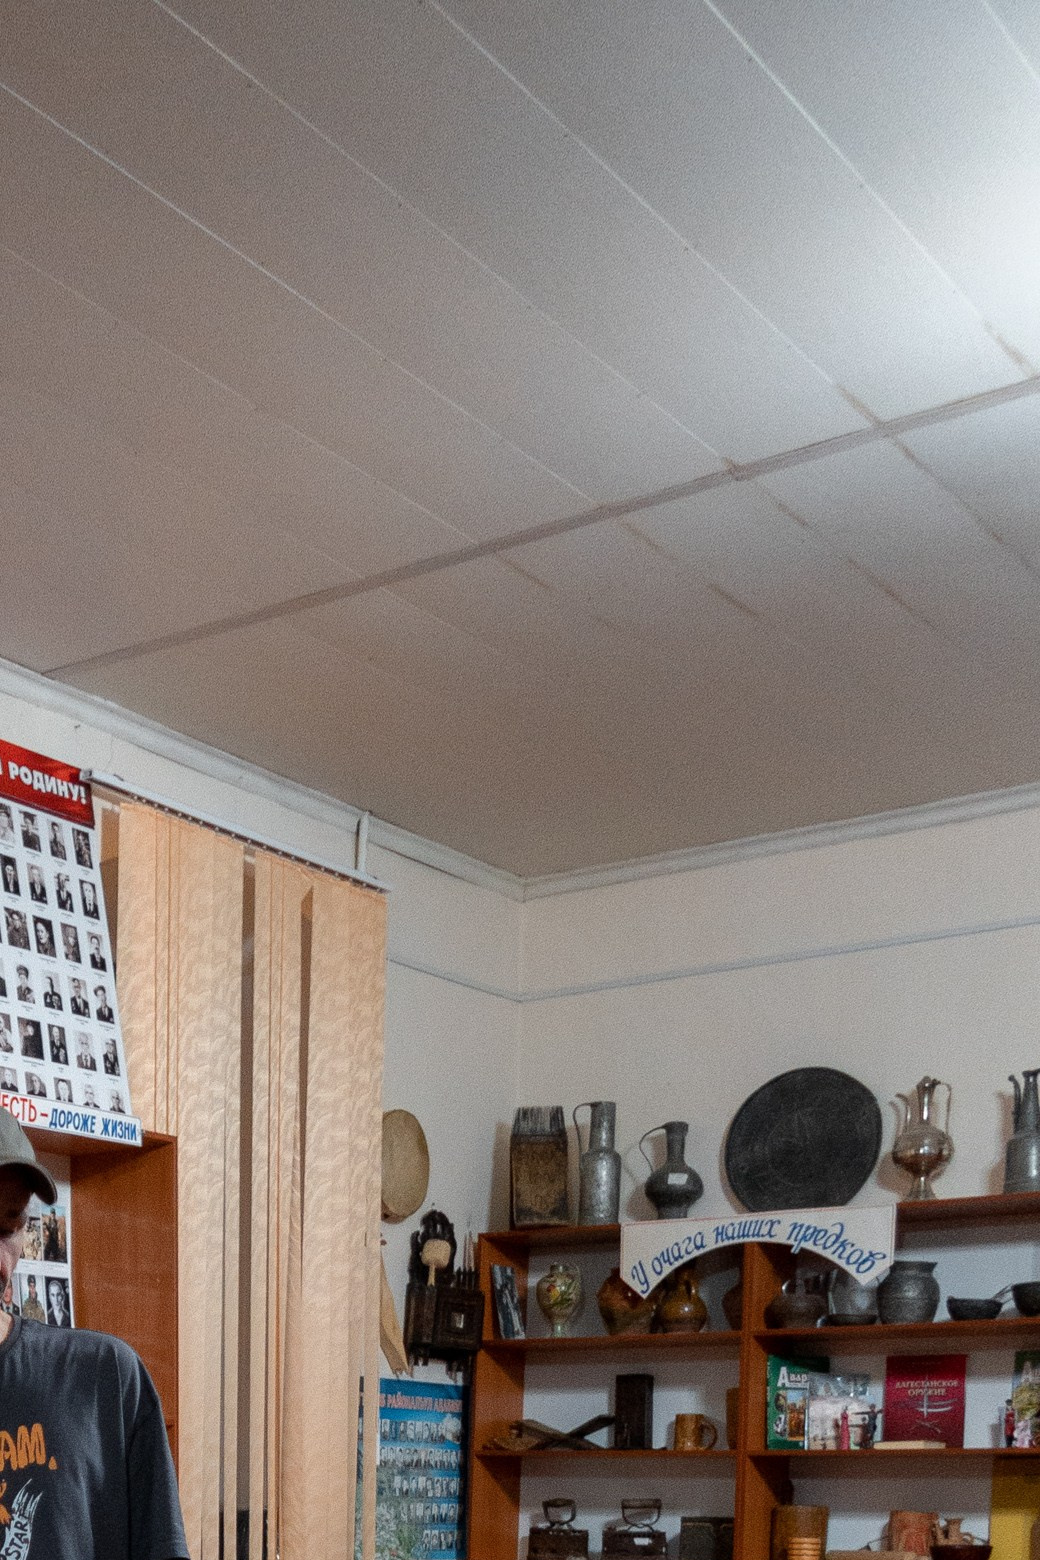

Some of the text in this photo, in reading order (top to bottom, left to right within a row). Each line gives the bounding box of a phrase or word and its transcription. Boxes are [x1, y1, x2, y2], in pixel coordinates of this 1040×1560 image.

[8, 761, 87, 805] РОДИНУ!
[48, 1107, 96, 1135] ДОРОЖЕ
[99, 1117, 138, 1142] ЖИЗНИ
[631, 1218, 887, 1295] У очага наших предков
